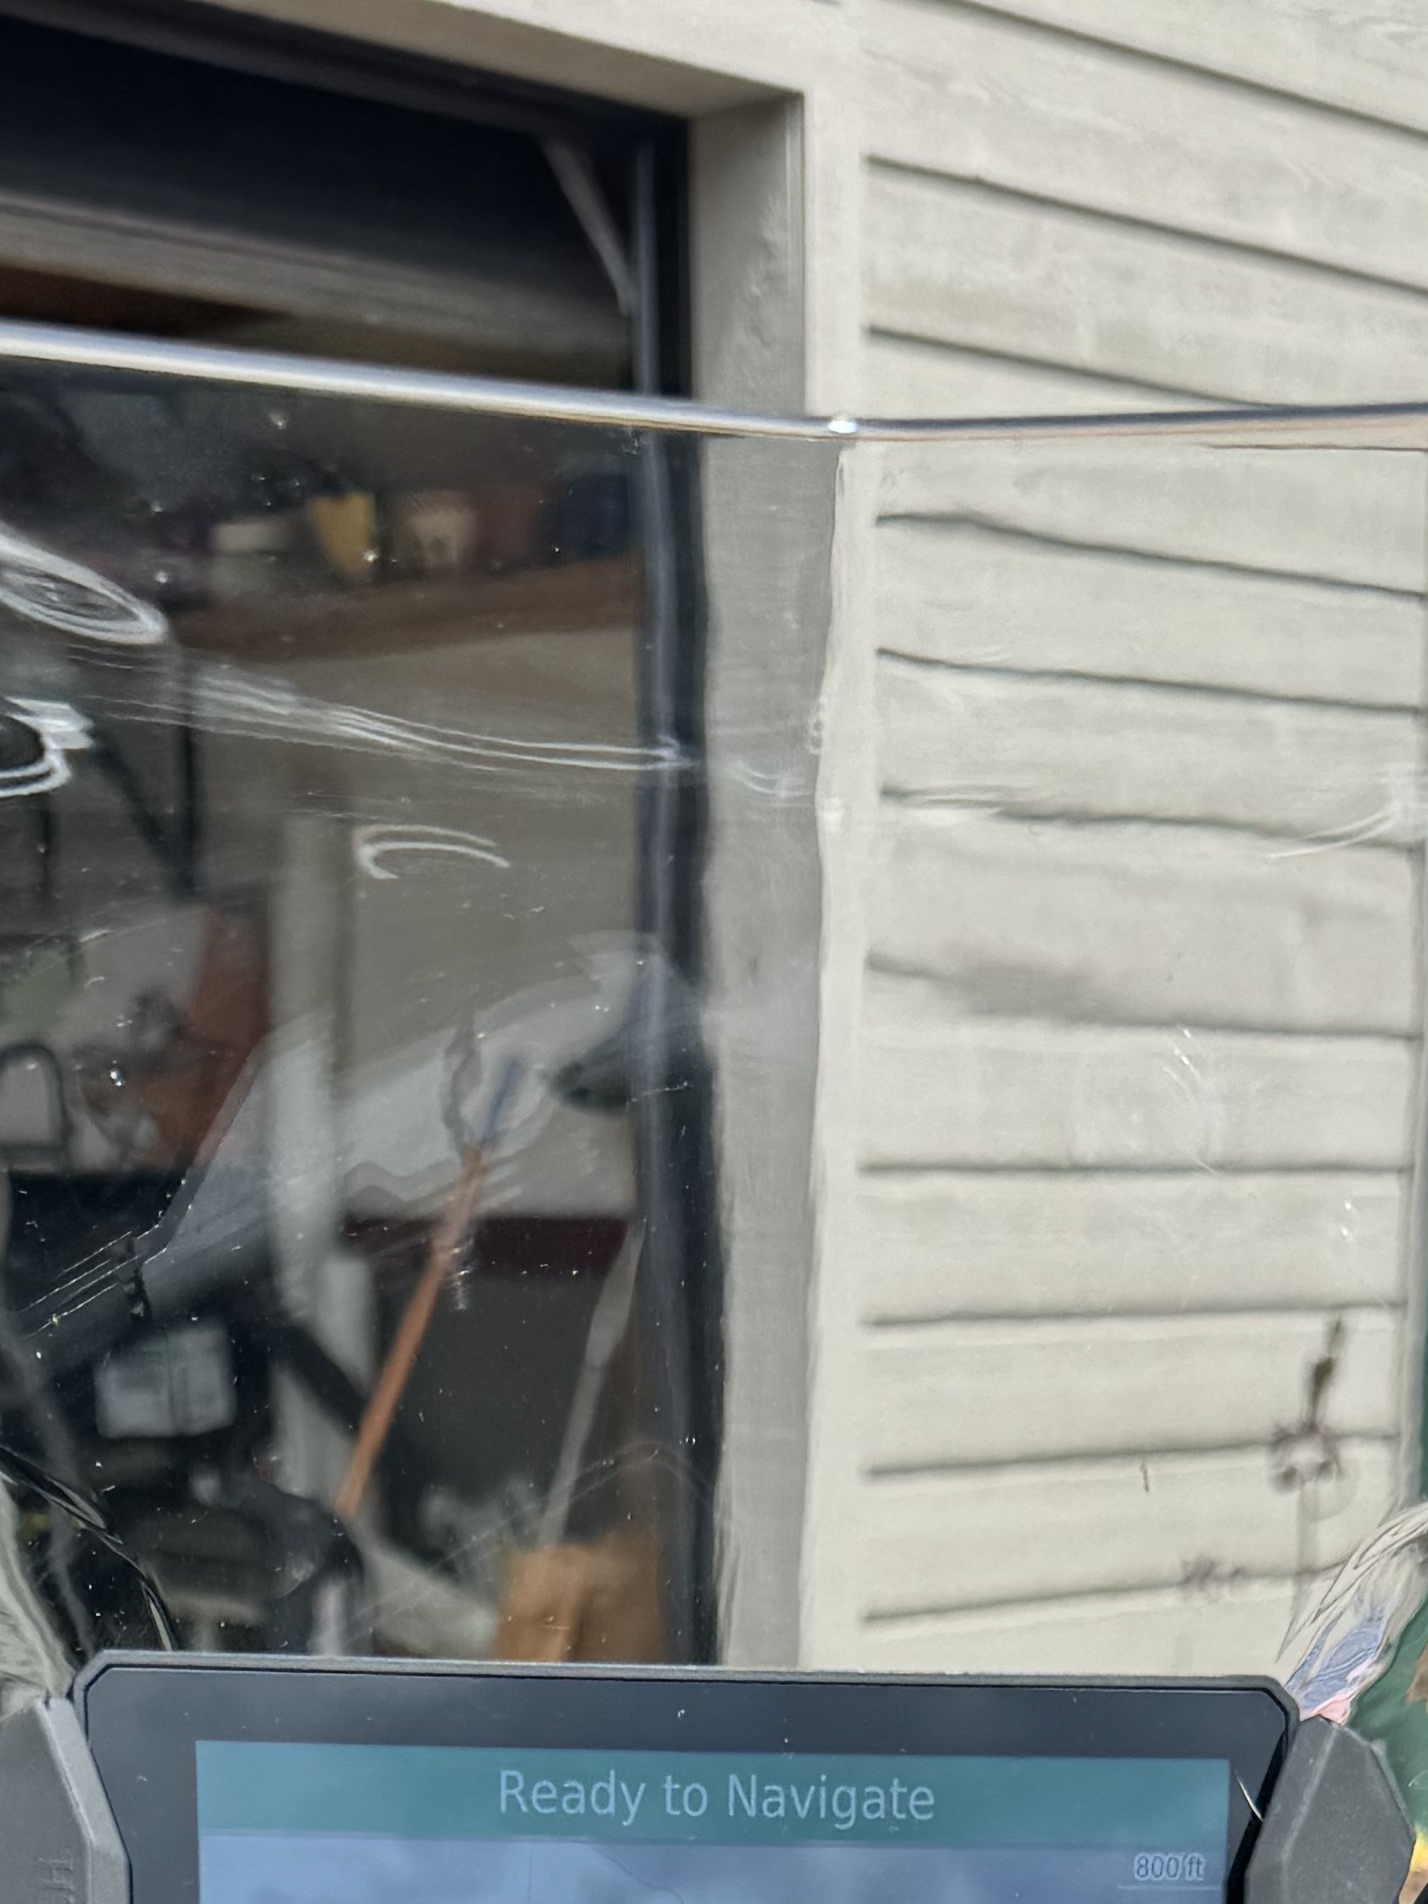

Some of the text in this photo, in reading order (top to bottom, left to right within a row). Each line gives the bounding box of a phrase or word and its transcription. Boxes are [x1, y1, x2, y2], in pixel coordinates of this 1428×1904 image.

[499, 1769, 936, 1831] Ready to Navigate
[1134, 1853, 1204, 1880] 800 ft
